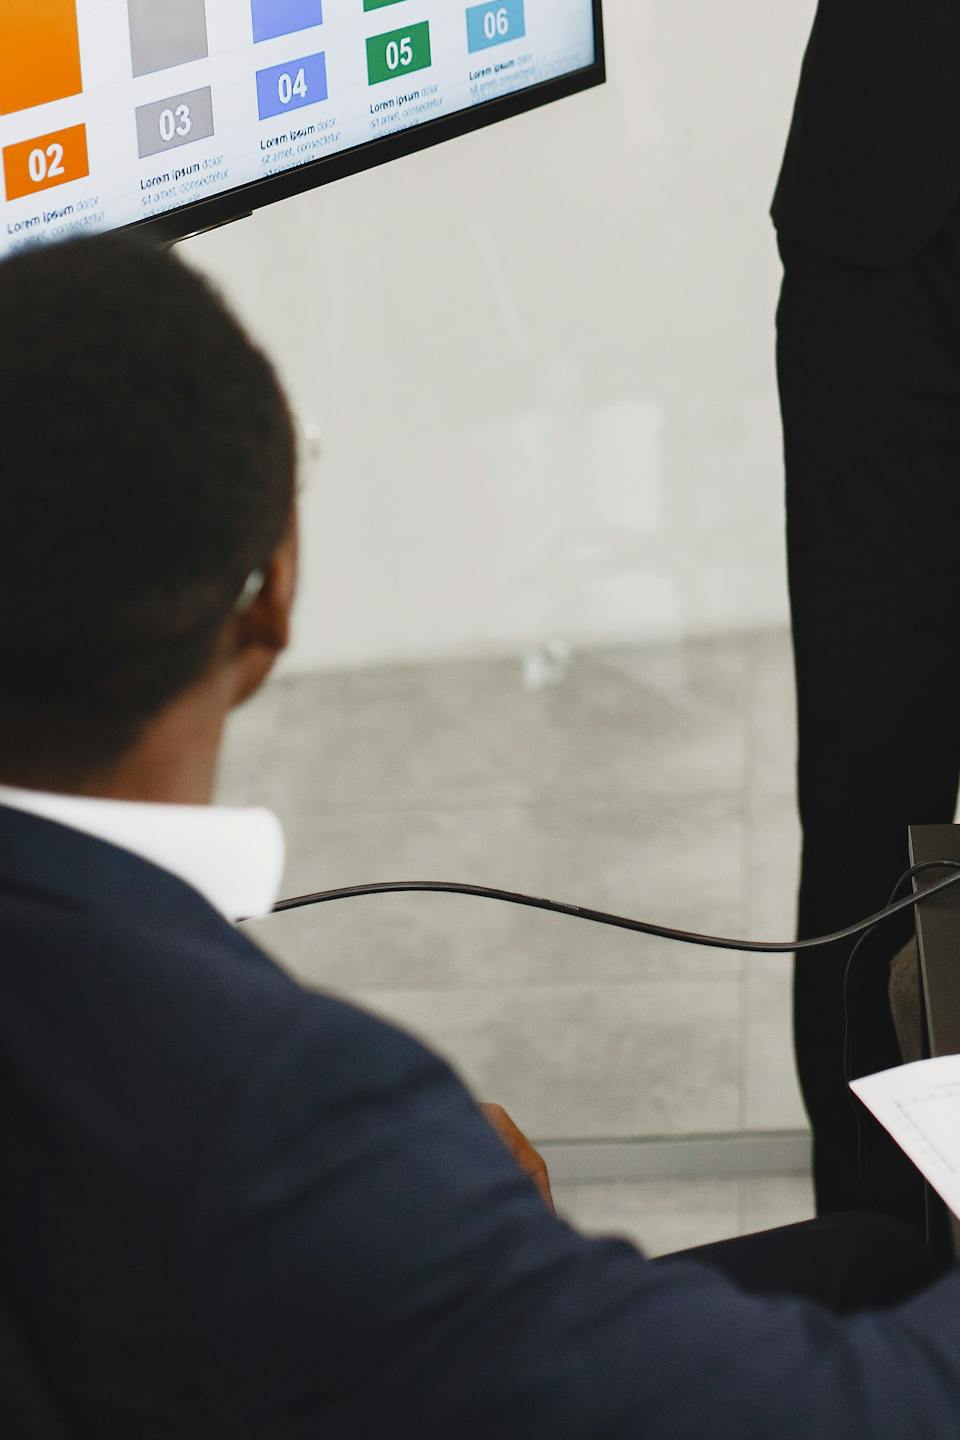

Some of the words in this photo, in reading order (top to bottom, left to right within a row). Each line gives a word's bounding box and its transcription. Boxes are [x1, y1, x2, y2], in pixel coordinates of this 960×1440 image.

[484, 8, 509, 39] 06
[385, 37, 413, 70] 05
[278, 68, 308, 104] 04
[370, 100, 395, 114] Lorem
[396, 91, 420, 106] ipsum
[159, 104, 192, 141] 03
[260, 134, 288, 150] Lorem
[290, 125, 315, 141] ipsum
[28, 143, 65, 182] 02
[140, 173, 170, 190] Lorem
[172, 163, 200, 181] ipsum
[7, 216, 40, 234] Lorem
[43, 205, 74, 224] ipsum
